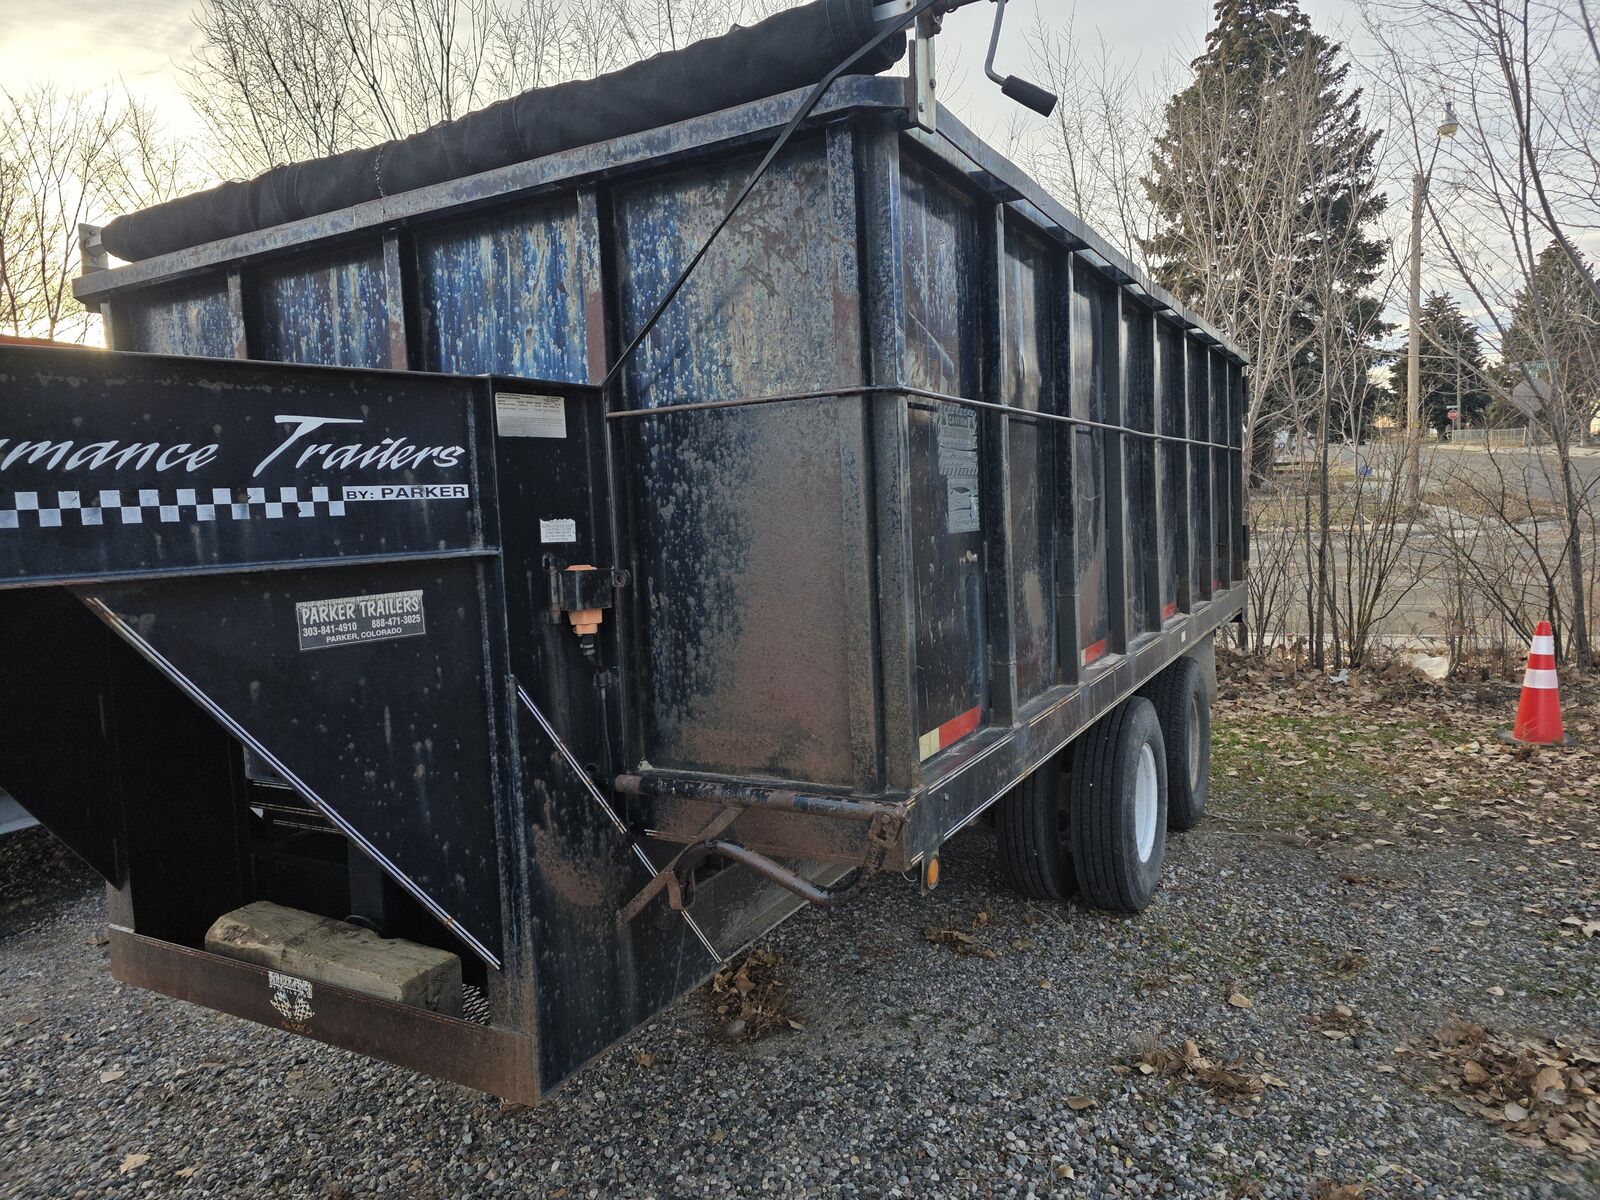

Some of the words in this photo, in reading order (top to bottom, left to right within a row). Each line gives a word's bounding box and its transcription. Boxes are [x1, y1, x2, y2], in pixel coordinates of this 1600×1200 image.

[253, 415, 465, 477] Trailers
[346, 490, 374, 499] BY:
[381, 486, 466, 499] PARKER
[302, 603, 356, 625] PARKER
[359, 596, 420, 618] TRAILERS
[302, 622, 357, 637] 303-841-4910
[371, 613, 421, 628] 888-471-3025
[326, 632, 360, 643] PARKER,
[361, 626, 402, 639] COLORADO
